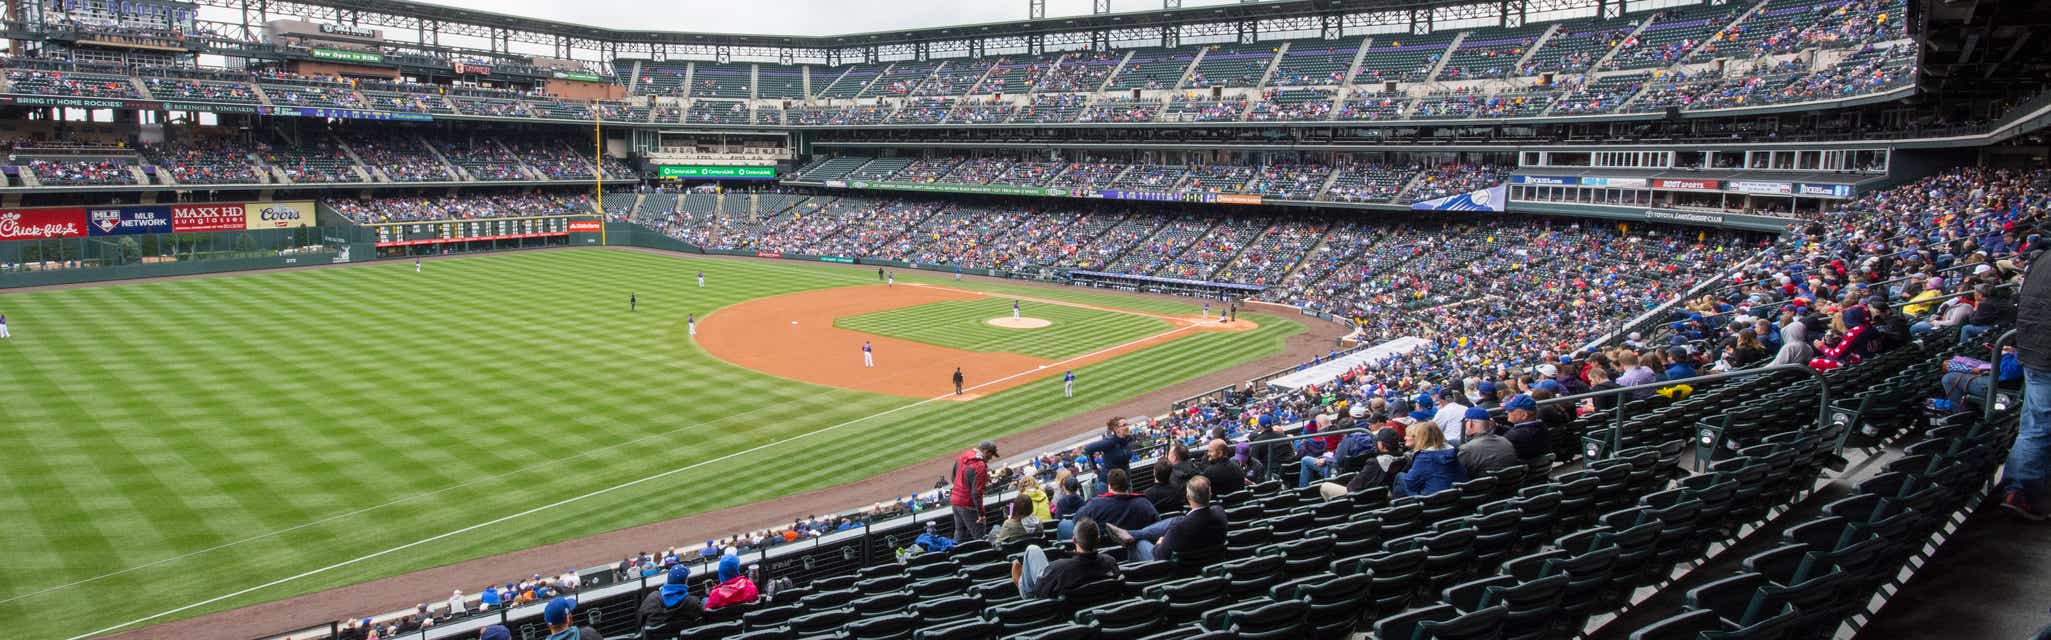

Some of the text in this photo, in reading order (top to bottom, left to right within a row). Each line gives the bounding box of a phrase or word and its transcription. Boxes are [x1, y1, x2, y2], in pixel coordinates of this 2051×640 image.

[107, 0, 199, 21] ROOFTOP
[84, 100, 123, 108] ROCKIES!
[174, 103, 255, 113] BERINGER VINEYARDS
[93, 210, 118, 219] MLB
[134, 212, 154, 220] MLB
[175, 207, 244, 218] MAXX HD
[260, 207, 300, 221] Coors
[0, 217, 78, 238] Chick-fil-A
[121, 218, 167, 227] NETWORK
